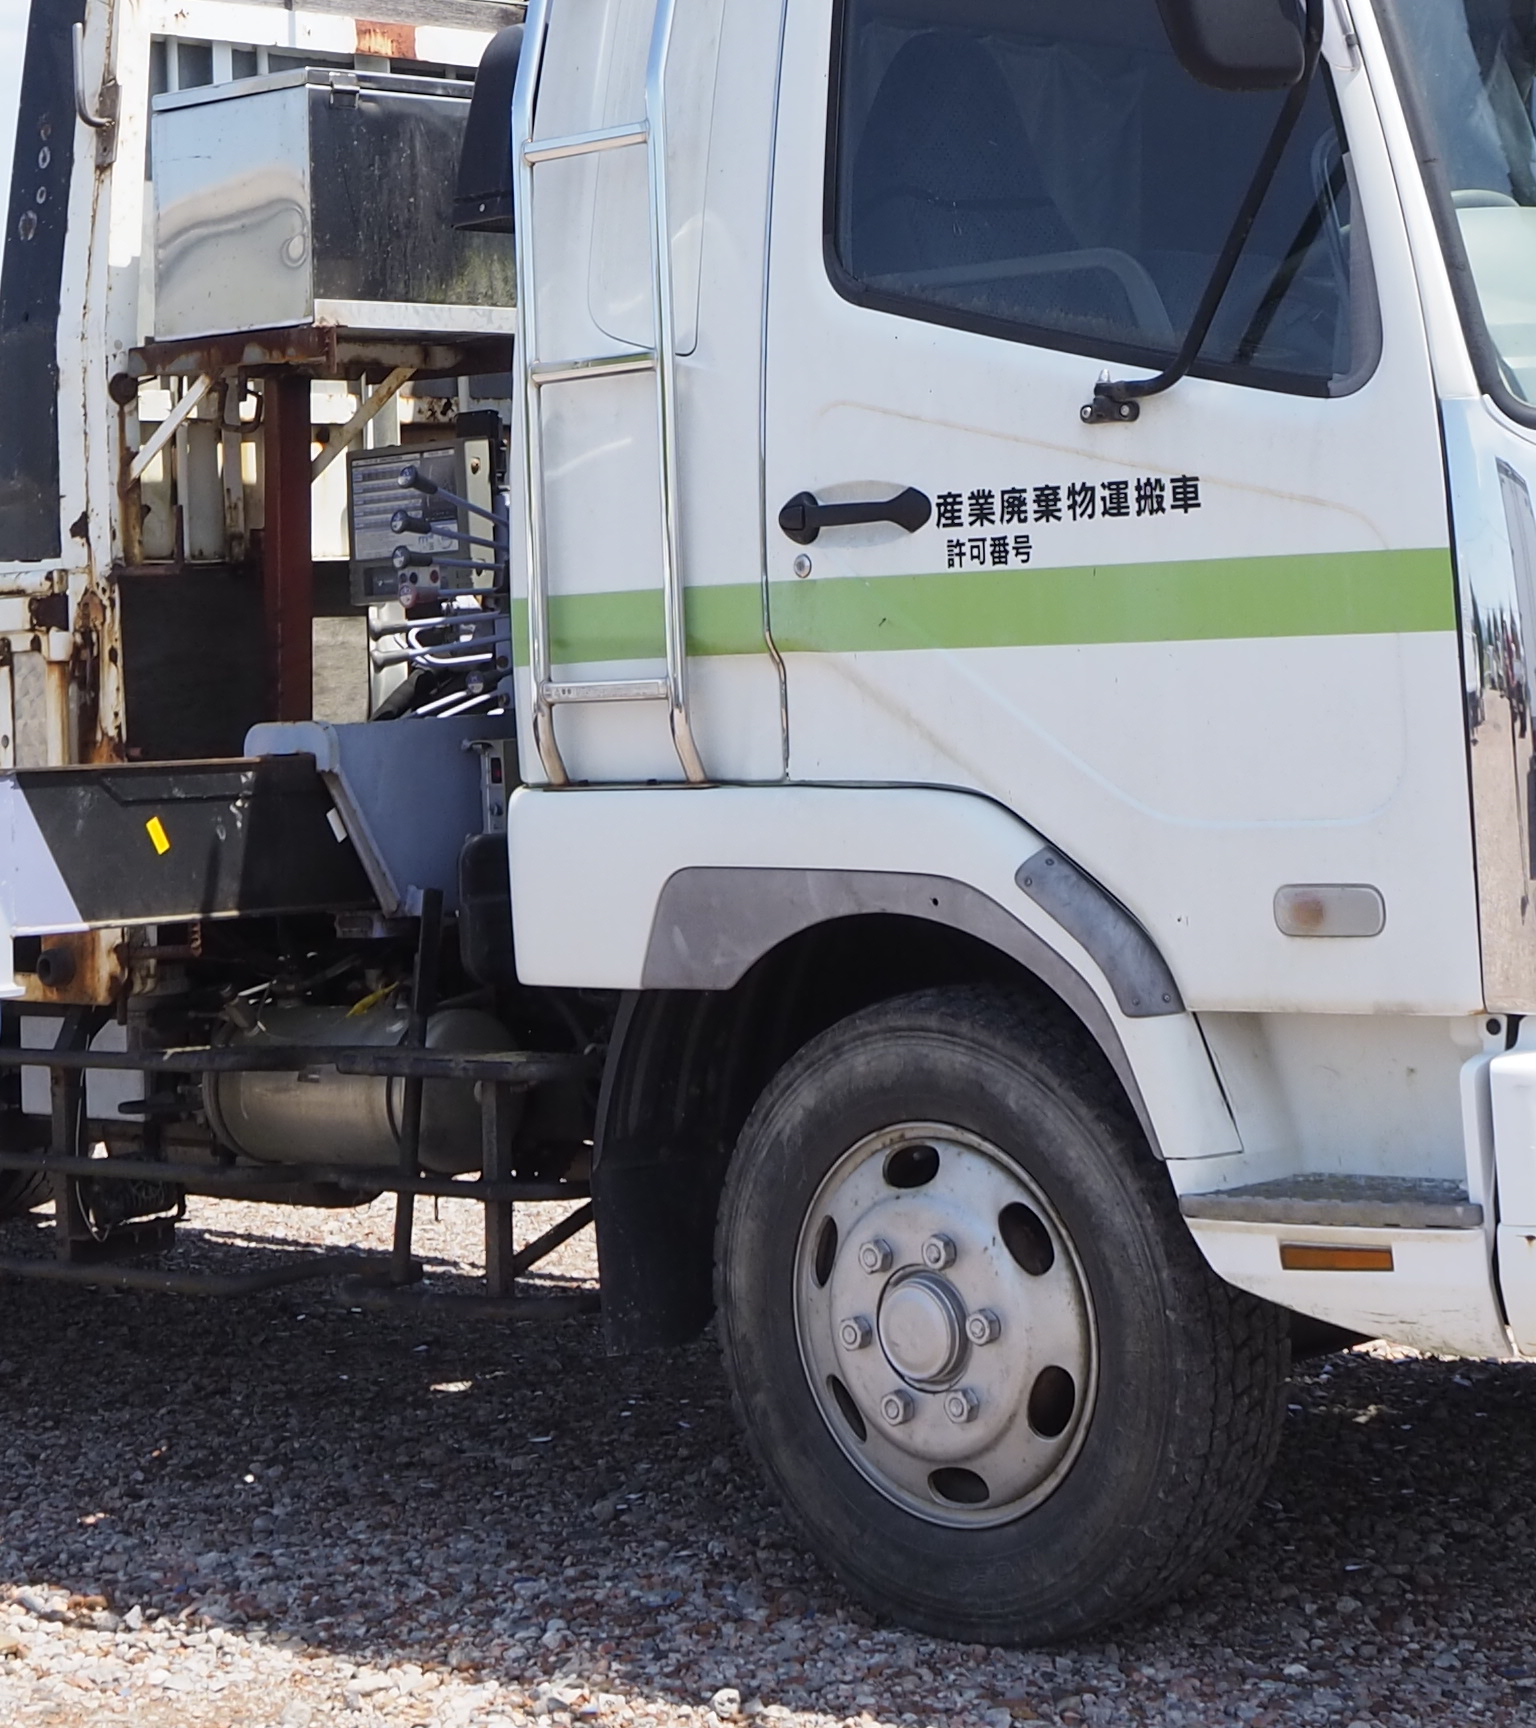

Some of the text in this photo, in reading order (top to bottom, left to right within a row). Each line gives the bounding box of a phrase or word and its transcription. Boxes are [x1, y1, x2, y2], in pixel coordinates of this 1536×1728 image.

[935, 475, 1202, 529] 産業廃棄物運搬車
[947, 534, 1033, 569] 許可番号
